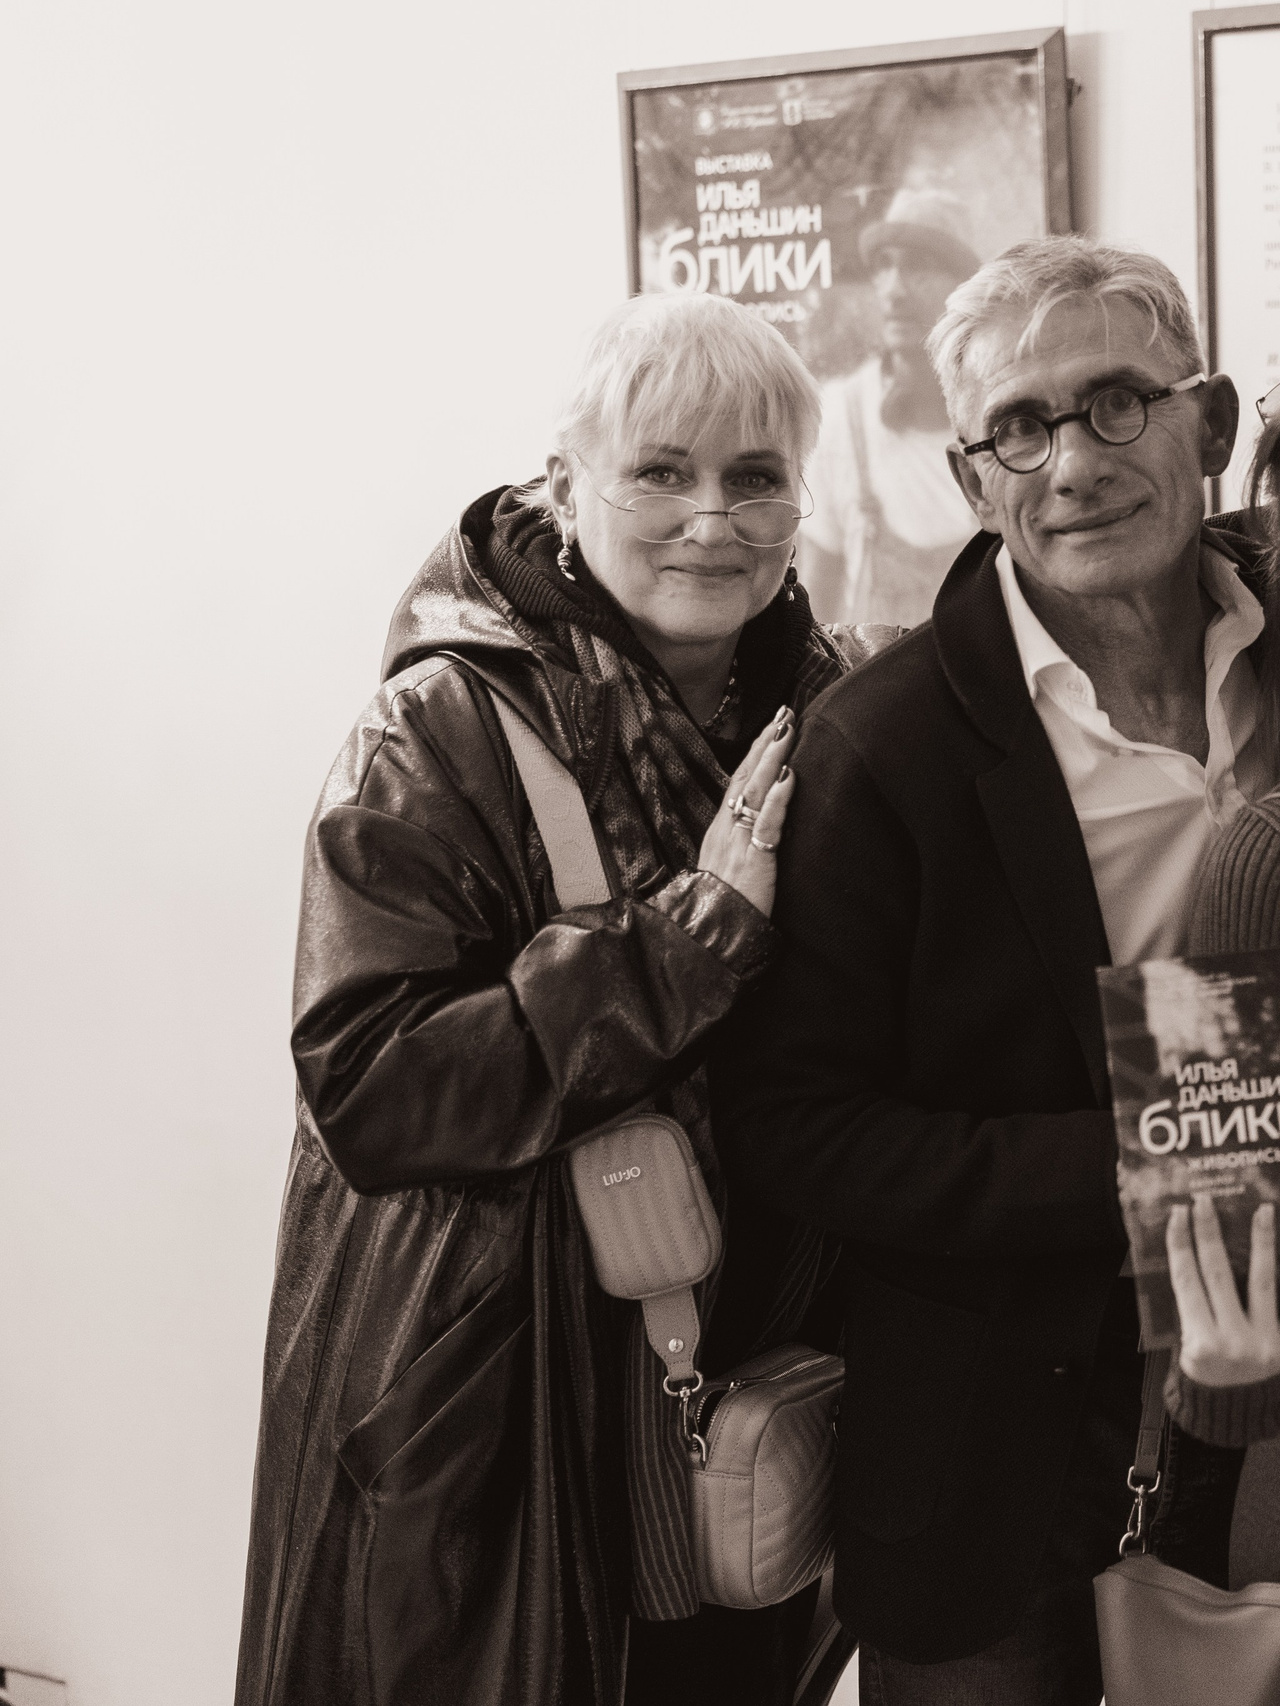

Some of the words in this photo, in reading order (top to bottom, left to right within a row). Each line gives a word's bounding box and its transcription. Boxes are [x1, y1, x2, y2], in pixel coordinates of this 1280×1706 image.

[697, 179, 760, 210] ИЛЬЯ
[698, 205, 822, 246] ДАНЬШИН
[1175, 1058, 1238, 1086] ИЛЬЯ
